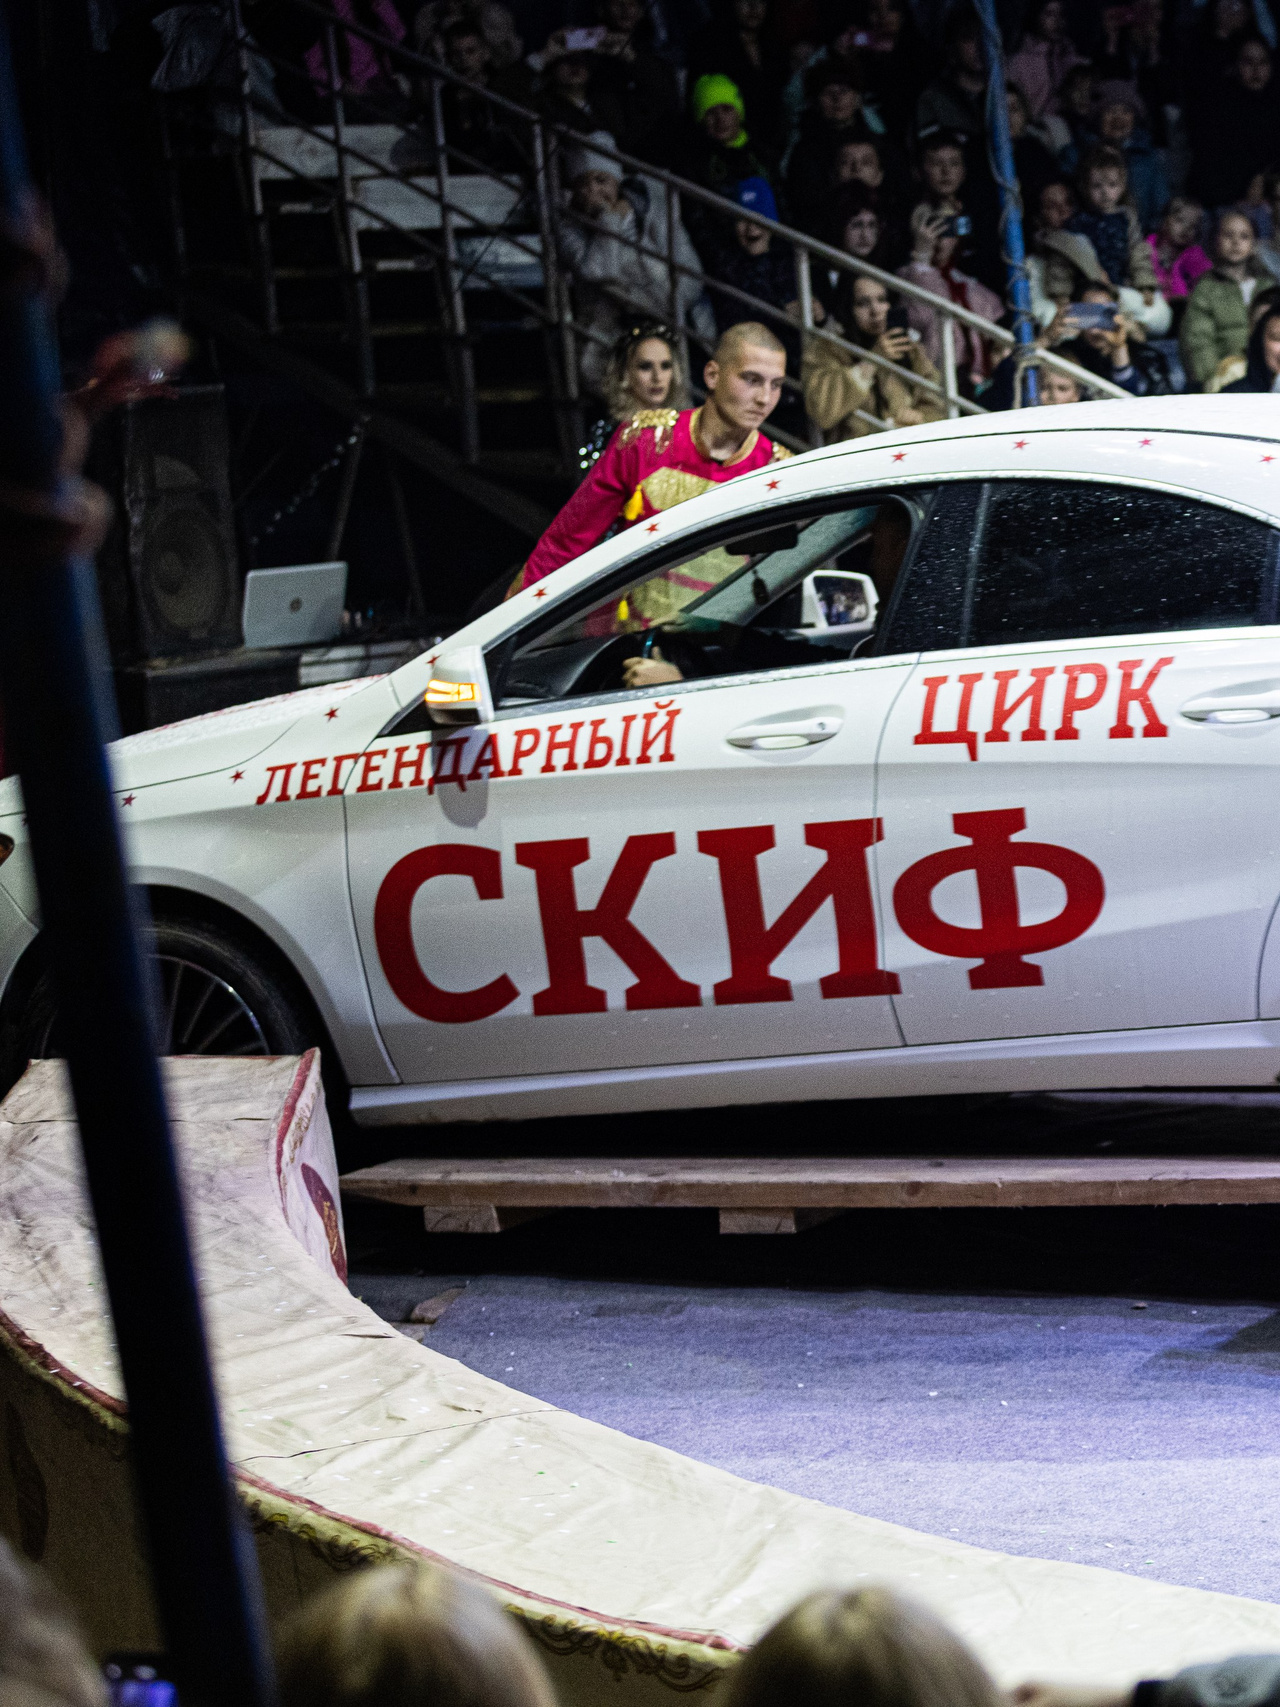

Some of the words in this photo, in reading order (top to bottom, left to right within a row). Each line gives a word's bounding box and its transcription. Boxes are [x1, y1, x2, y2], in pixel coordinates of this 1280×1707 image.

[256, 700, 683, 806] ЛЕГЕНДАРНЫЙ
[912, 656, 1175, 763] ЦИРК
[374, 806, 1105, 1024] СКИФ
